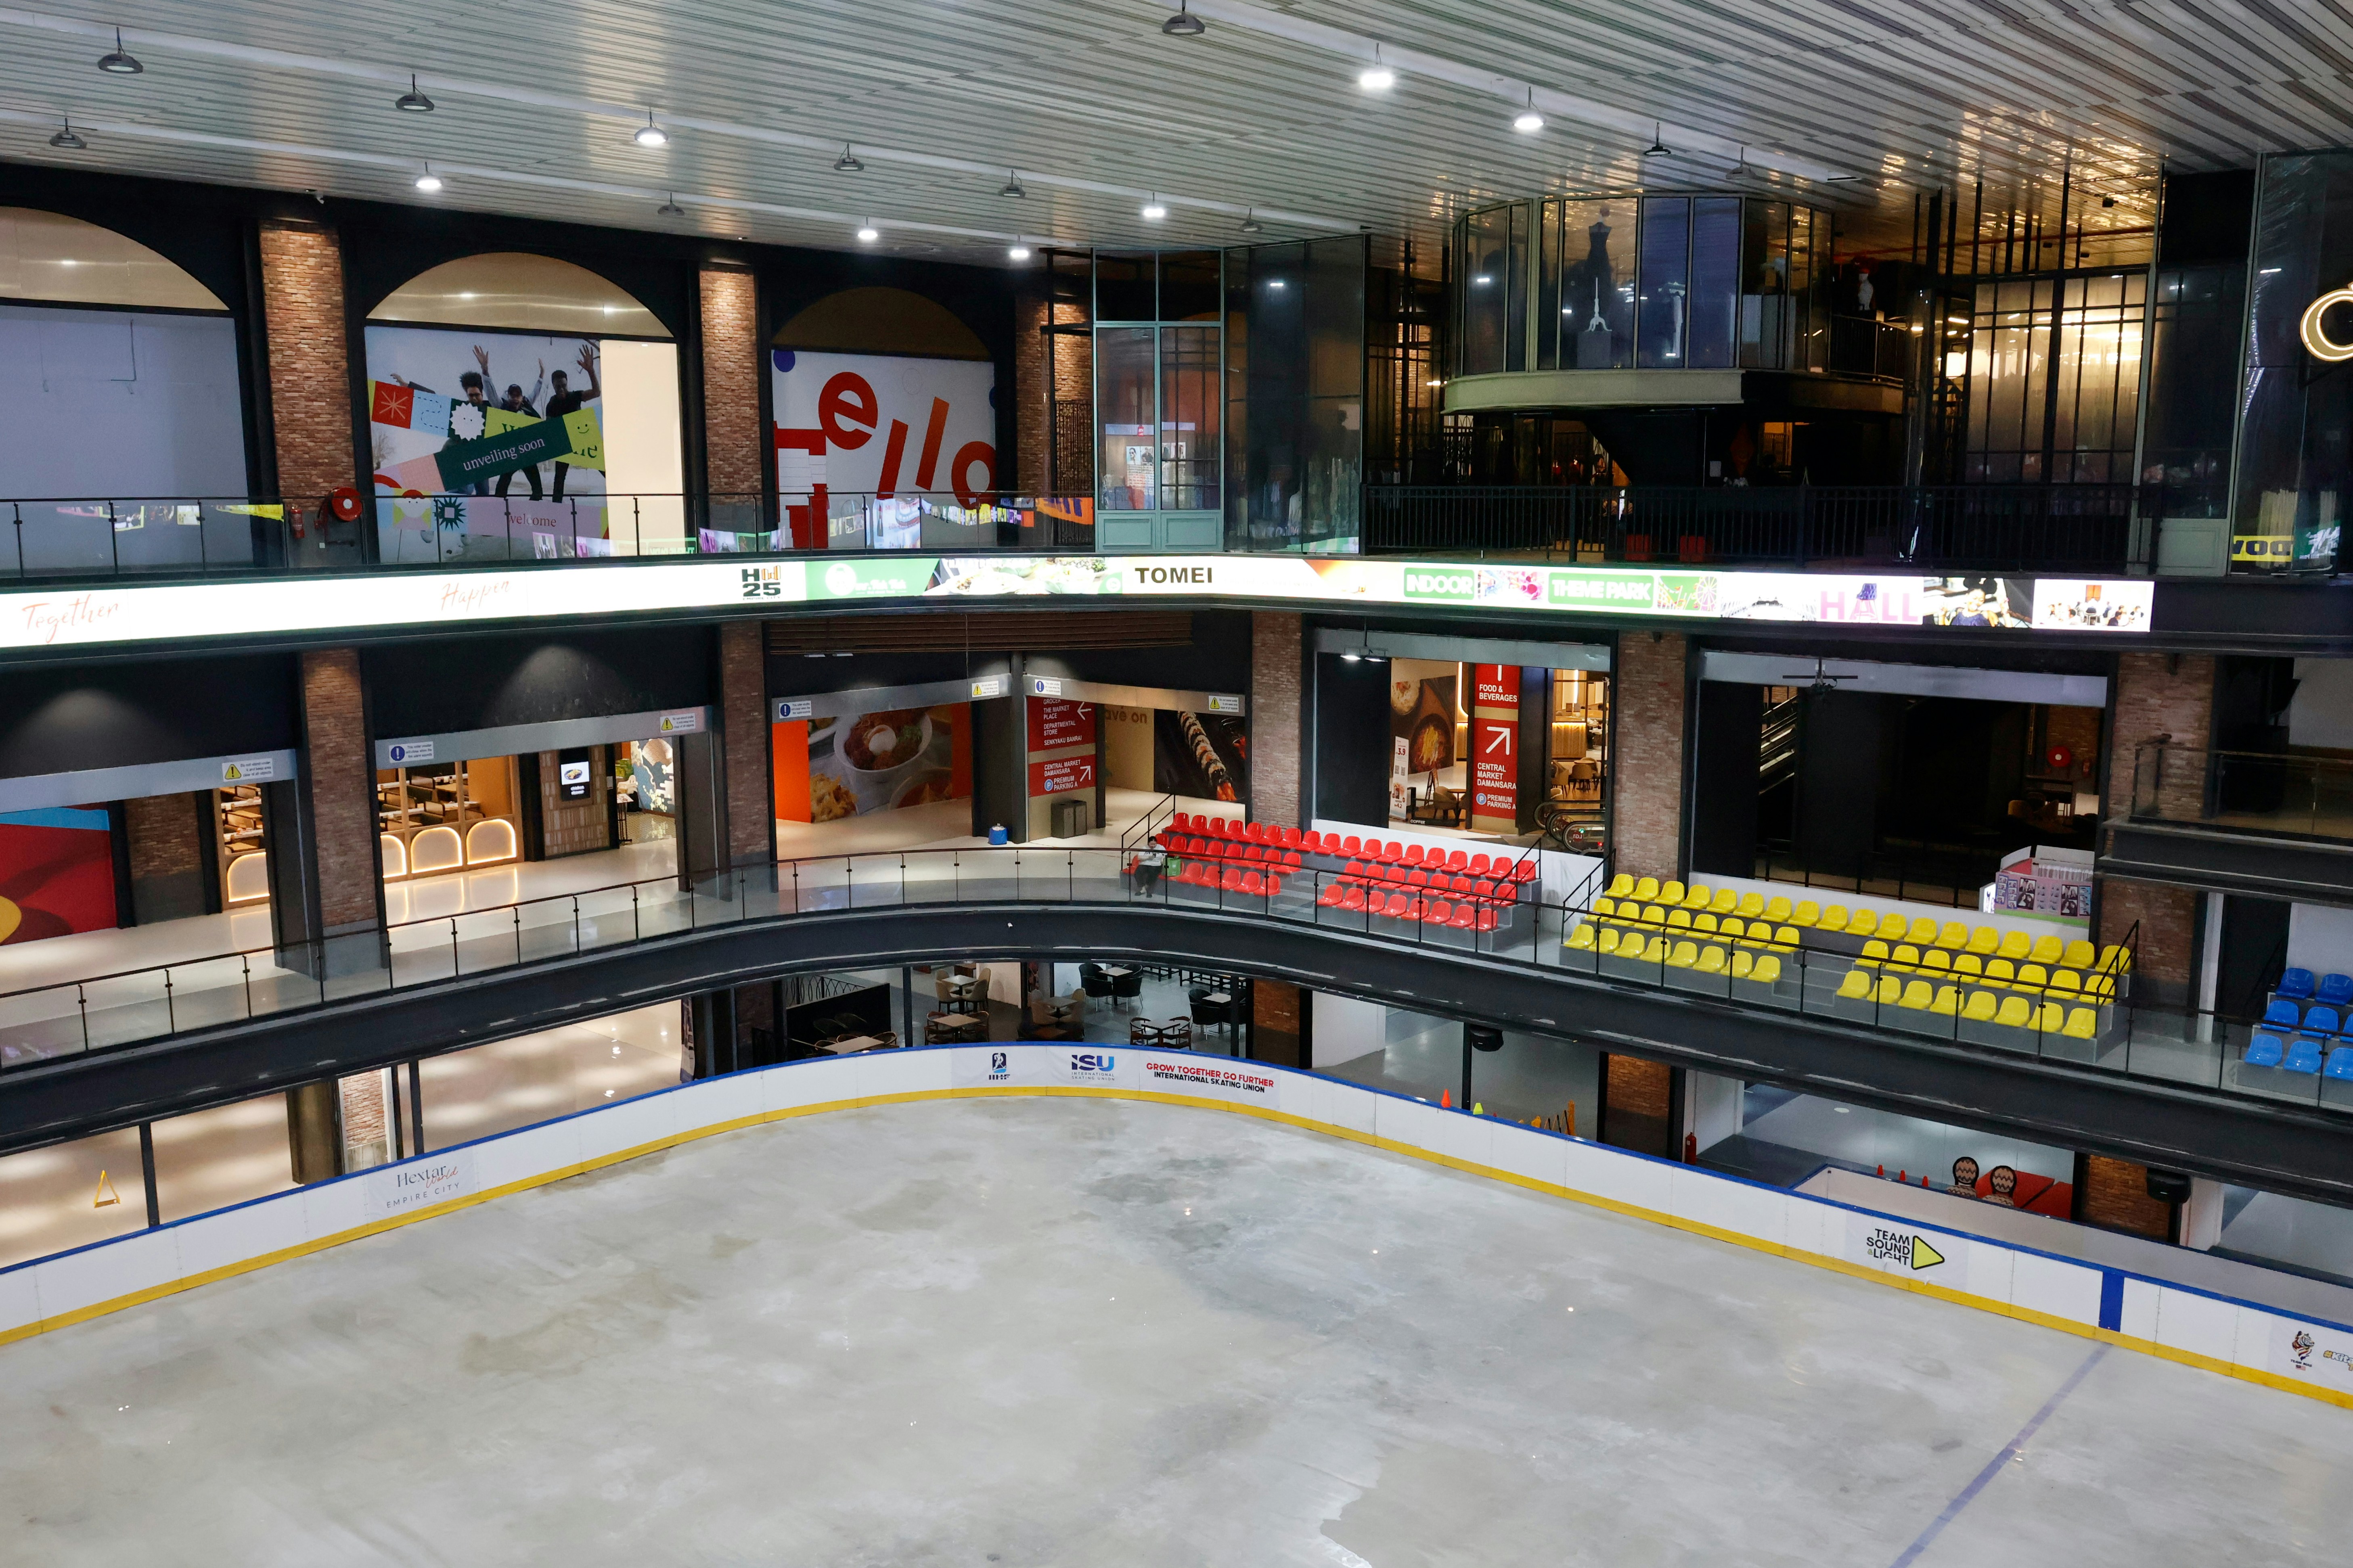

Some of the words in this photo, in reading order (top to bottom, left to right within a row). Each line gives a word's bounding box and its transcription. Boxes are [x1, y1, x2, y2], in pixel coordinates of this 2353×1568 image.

[463, 447, 517, 471] unveiling
[518, 437, 545, 454] soon
[1135, 567, 1212, 584] TOMEI
[743, 582, 781, 596] 25
[1406, 573, 1474, 595] INDOOR
[1552, 579, 1605, 599] THEME
[1606, 580, 1653, 602] PARK
[441, 580, 509, 613] Happen
[22, 594, 119, 644] Together
[1479, 684, 1497, 693] FOOD
[1479, 692, 1518, 702] BEVERAGES
[1044, 720, 1076, 730] DEPARTMENTAL
[1131, 712, 1147, 724] on
[1044, 737, 1066, 746] SENKYAKU
[1044, 768, 1070, 777] DAMANSARA
[1477, 762, 1506, 772] CENTRAL
[1054, 776, 1074, 784] PREMIUM
[1477, 771, 1503, 780] MARKET
[1054, 782, 1074, 791] PARKING
[1477, 779, 1517, 790] DAMANSARA
[1487, 794, 1513, 803] PREMIUM
[1487, 801, 1511, 809] PARKING
[1072, 1054, 1114, 1072] ISU
[1146, 1062, 1176, 1073] GROW
[1178, 1066, 1221, 1078] TOGETHER
[1223, 1072, 1237, 1081] GO
[1239, 1074, 1274, 1087] FURTHER
[1154, 1071, 1209, 1083] INTERNATIONAL
[1210, 1078, 1241, 1089] SKATING
[1243, 1083, 1265, 1093] UNION
[397, 1165, 446, 1187] Hextar
[426, 1166, 459, 1188] World
[386, 1191, 428, 1208] EMPIRE
[434, 1182, 460, 1195] CITY
[1875, 1228, 1910, 1246] TEAM
[1866, 1237, 1910, 1256] SOUND
